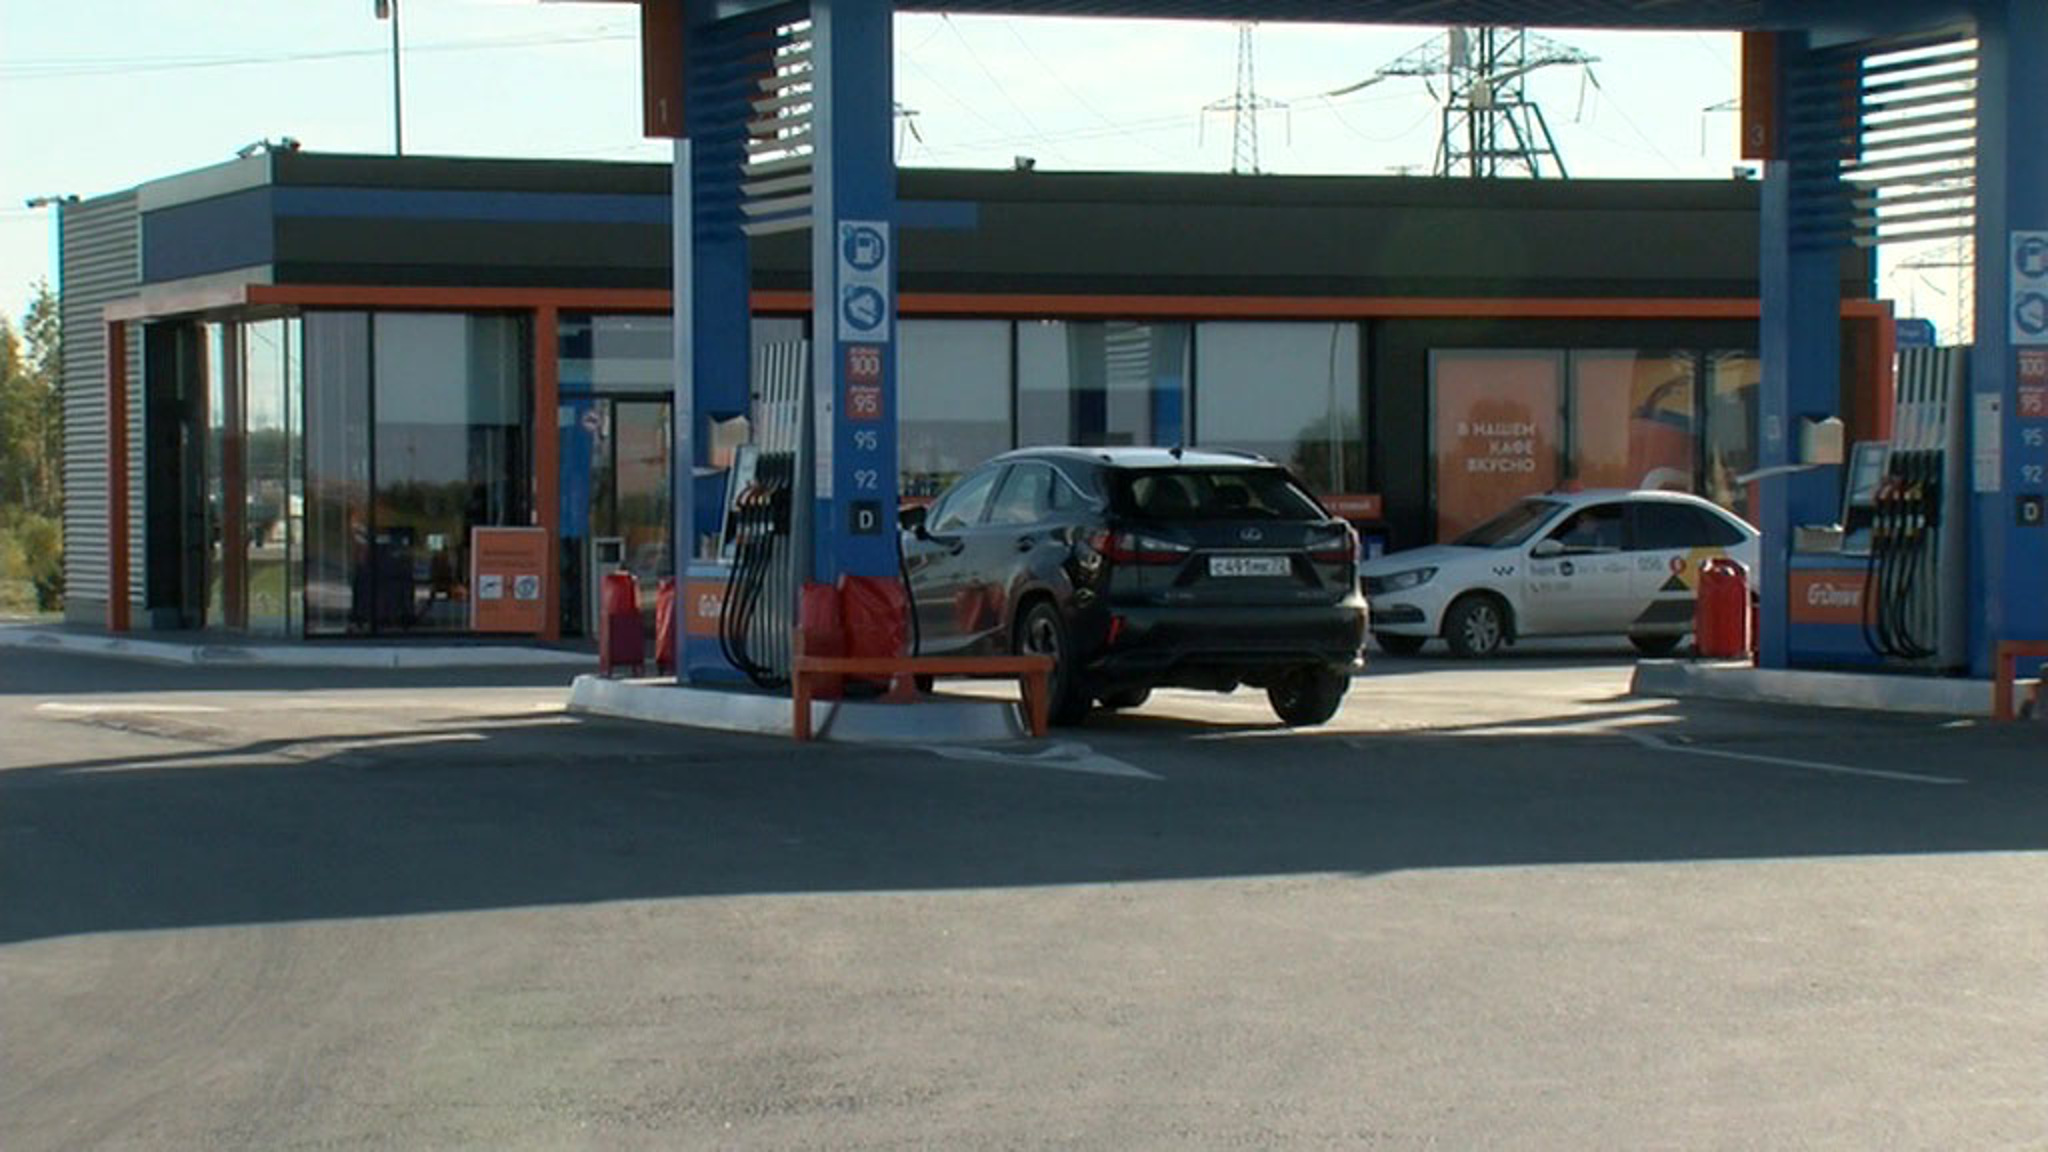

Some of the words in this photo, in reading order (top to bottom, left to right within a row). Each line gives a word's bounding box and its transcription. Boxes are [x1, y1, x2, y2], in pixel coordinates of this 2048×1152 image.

[849, 356, 880, 375] 100
[2019, 357, 2045, 375] 100
[853, 394, 877, 413] 95
[2020, 394, 2043, 412] 95
[853, 430, 877, 450] 95
[2021, 428, 2044, 447] 95
[1467, 458, 1536, 473] ВКУСНО
[2021, 465, 2044, 484] 92
[853, 469, 878, 489] 92
[859, 510, 874, 529] D
[2023, 502, 2038, 521] D
